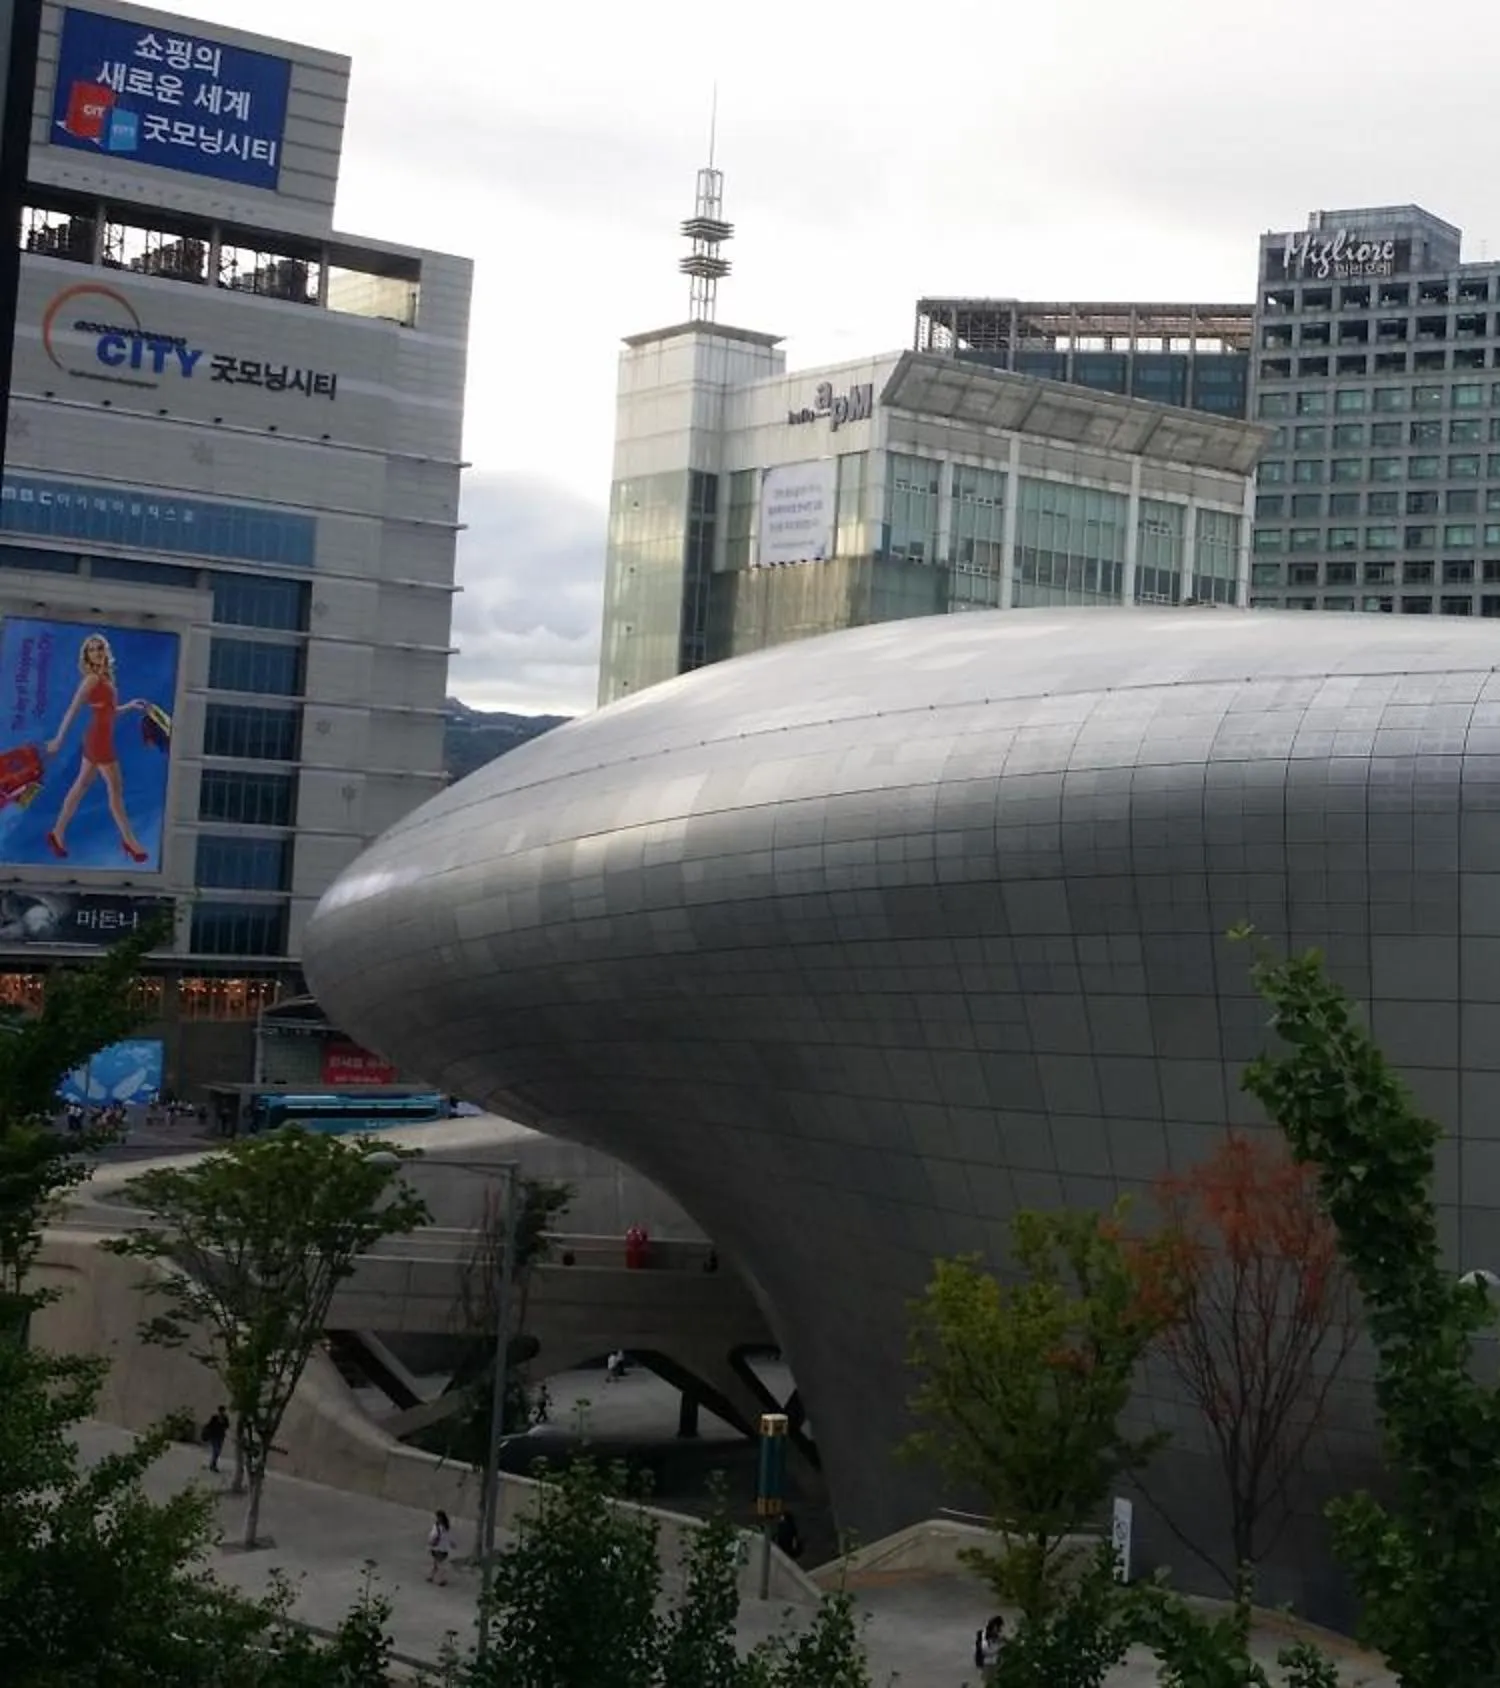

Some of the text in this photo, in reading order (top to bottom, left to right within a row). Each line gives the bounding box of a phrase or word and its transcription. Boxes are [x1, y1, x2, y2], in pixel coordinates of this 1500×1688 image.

[134, 33, 221, 77] 쇼핑의
[96, 61, 251, 121] 새로운 세계
[143, 113, 277, 167] 굿모닝시티
[1283, 229, 1395, 278] Migliore
[96, 333, 202, 378] CITY
[210, 354, 337, 401] 굿모닝시티
